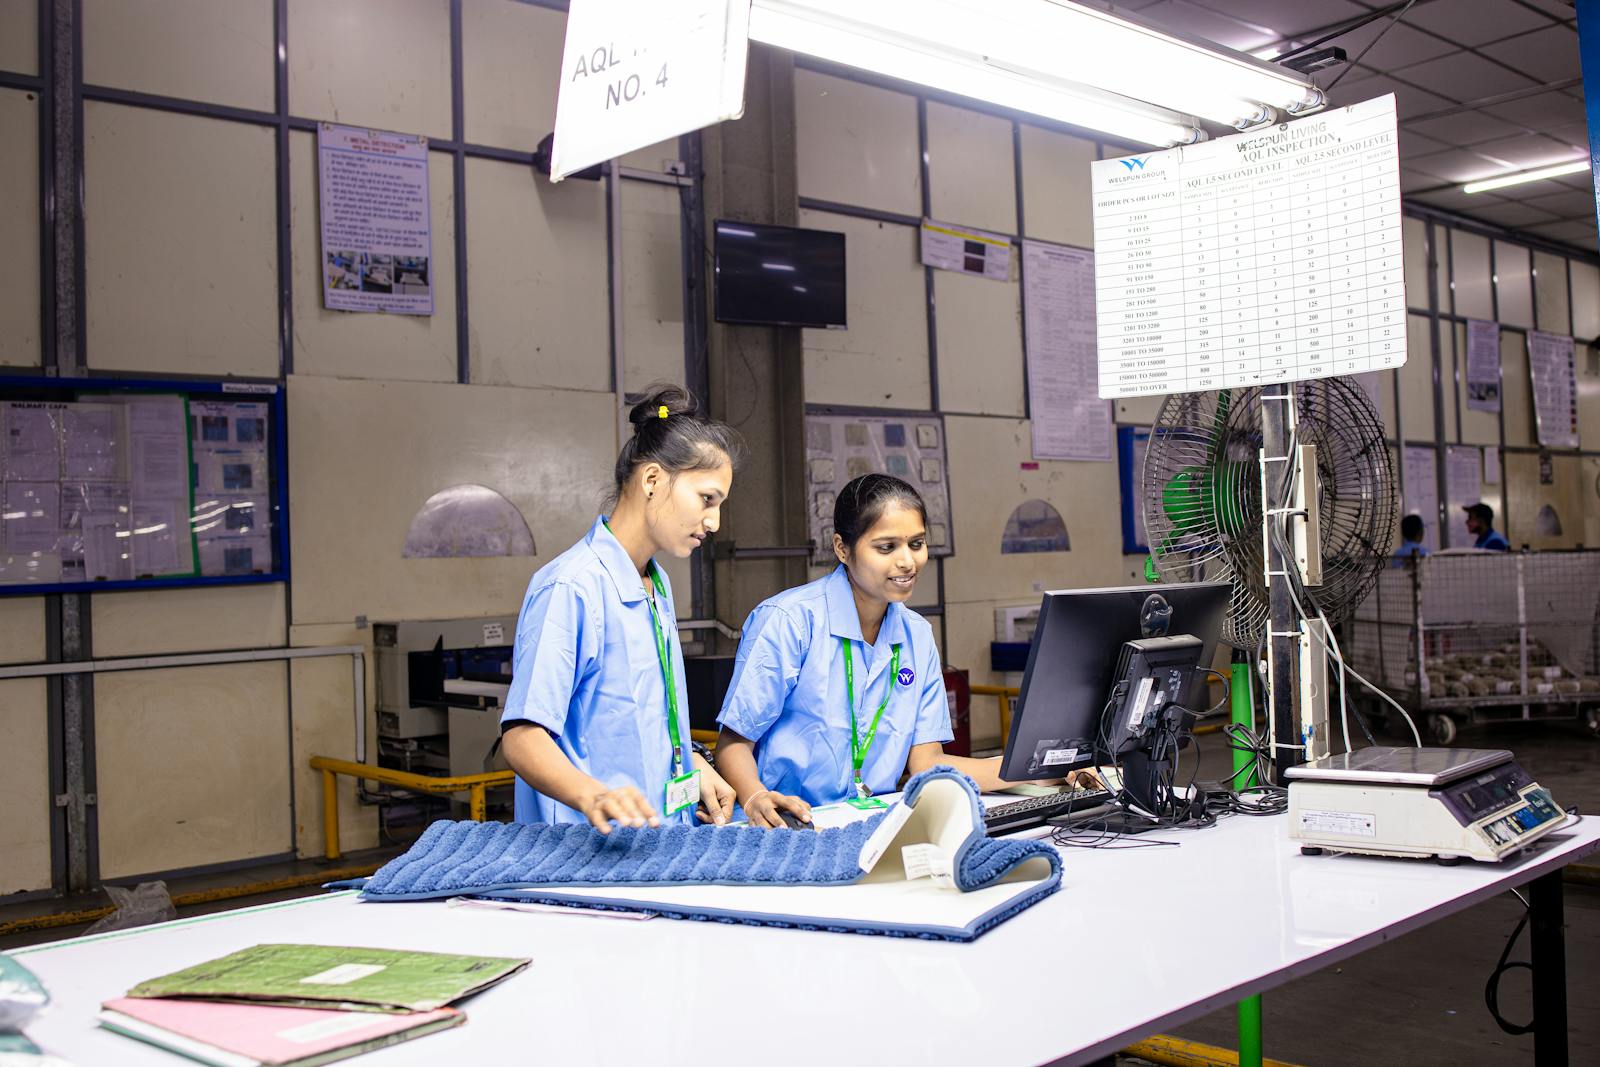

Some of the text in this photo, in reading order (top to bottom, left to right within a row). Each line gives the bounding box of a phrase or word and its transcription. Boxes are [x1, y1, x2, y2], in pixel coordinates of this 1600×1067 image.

[572, 43, 620, 82] AQL
[606, 62, 668, 110] NO. 4
[1236, 122, 1326, 152] WELSPUN LIVING
[1242, 132, 1336, 162] AQL INSPECTION
[1296, 134, 1391, 165] AQL 2.5 SECOND LEVEL
[1108, 174, 1140, 184] WELSPUN
[1186, 178, 1202, 188] AQL
[1218, 168, 1252, 181] SECOND
[1098, 198, 1121, 208] ORDER
